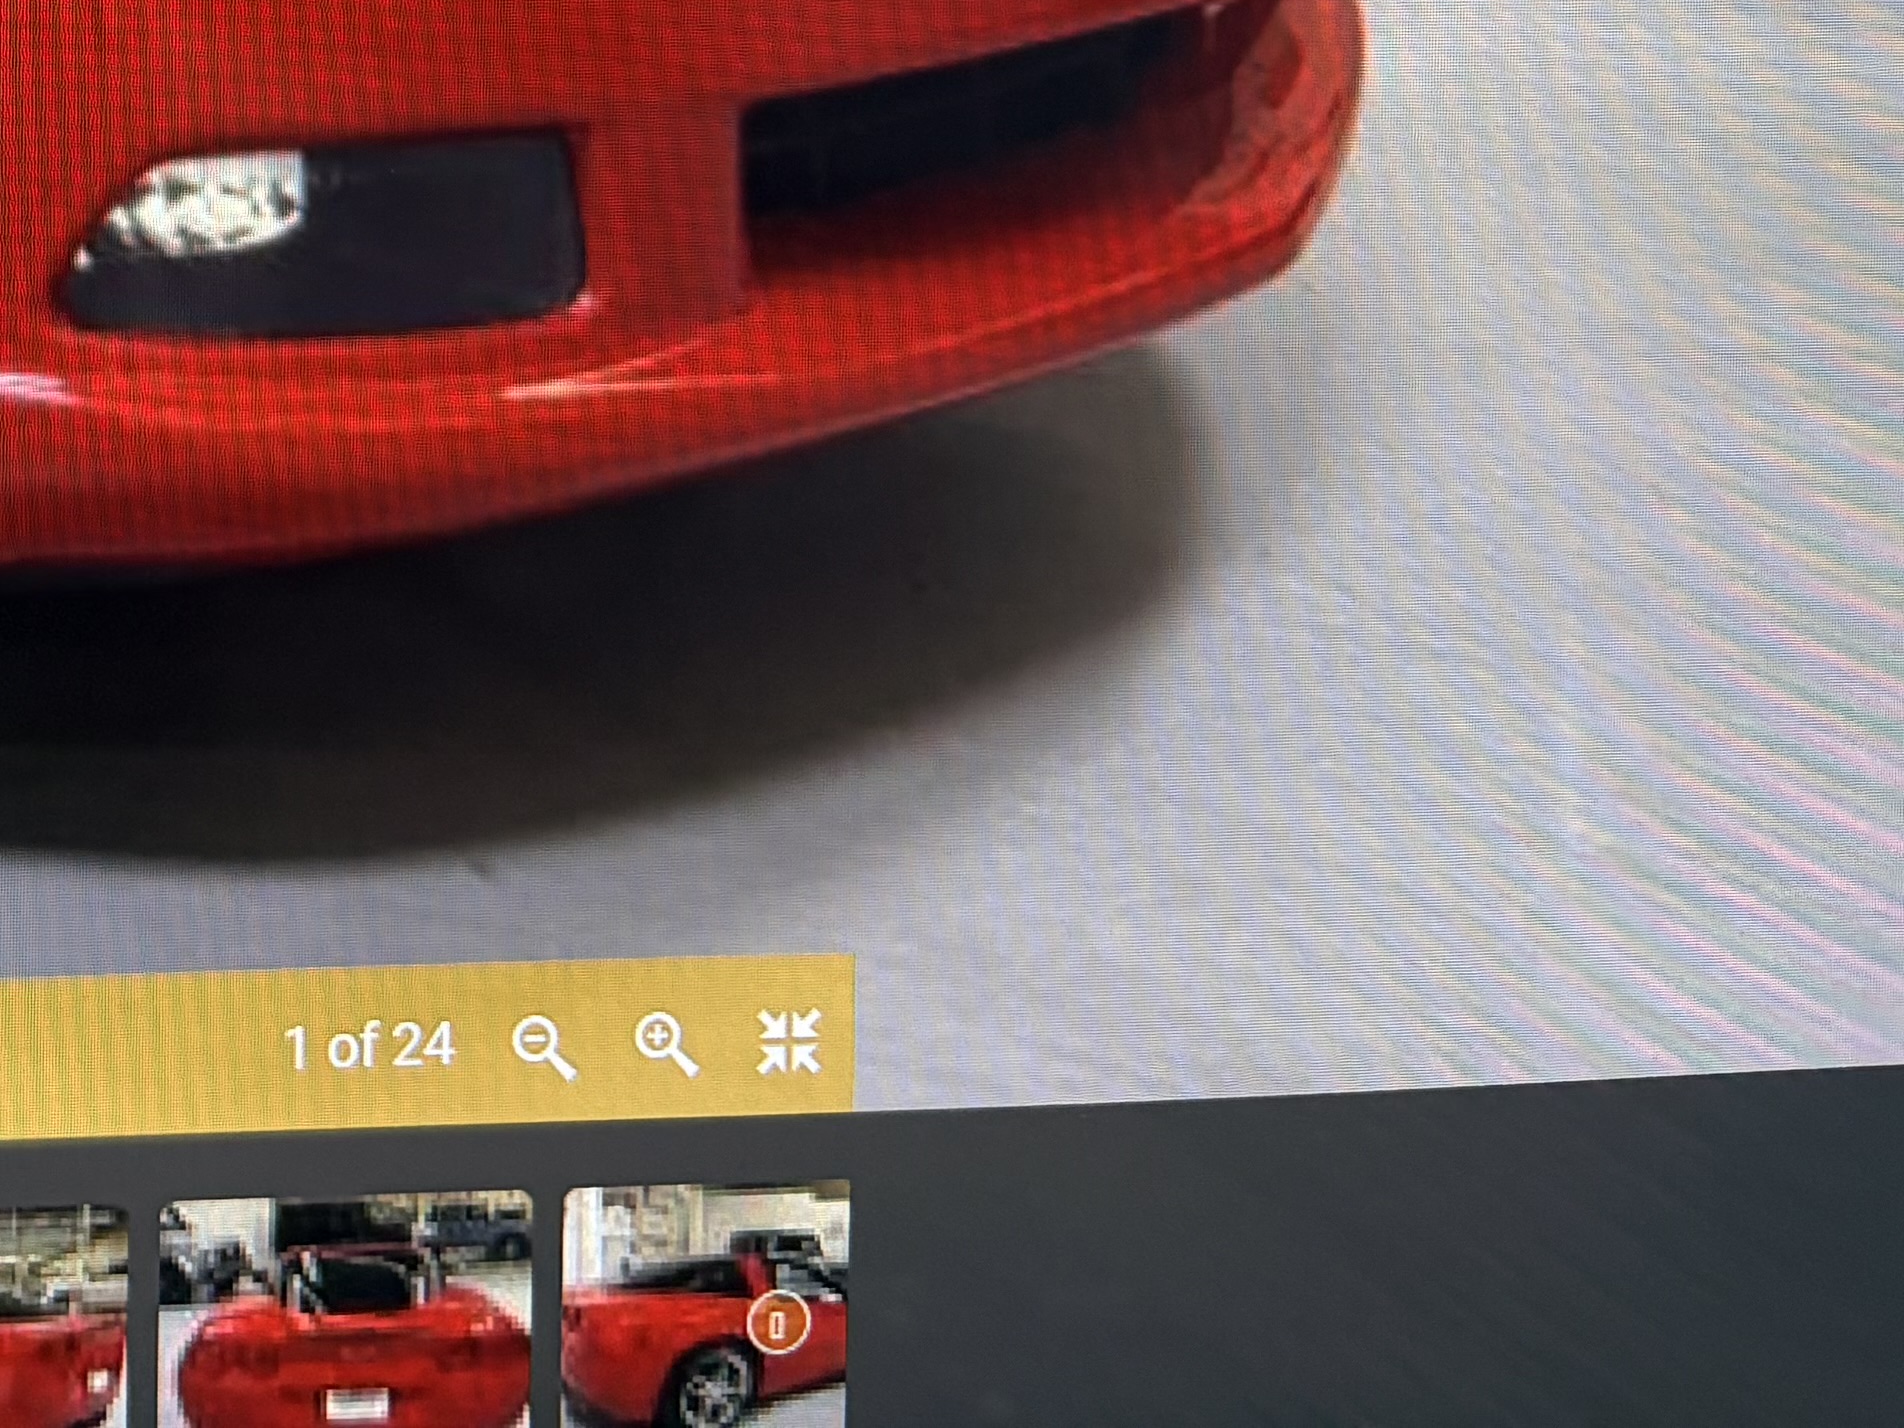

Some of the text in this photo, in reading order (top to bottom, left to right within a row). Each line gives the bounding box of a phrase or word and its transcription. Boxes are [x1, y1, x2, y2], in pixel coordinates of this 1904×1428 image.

[286, 1019, 456, 1071] 1 of 24
